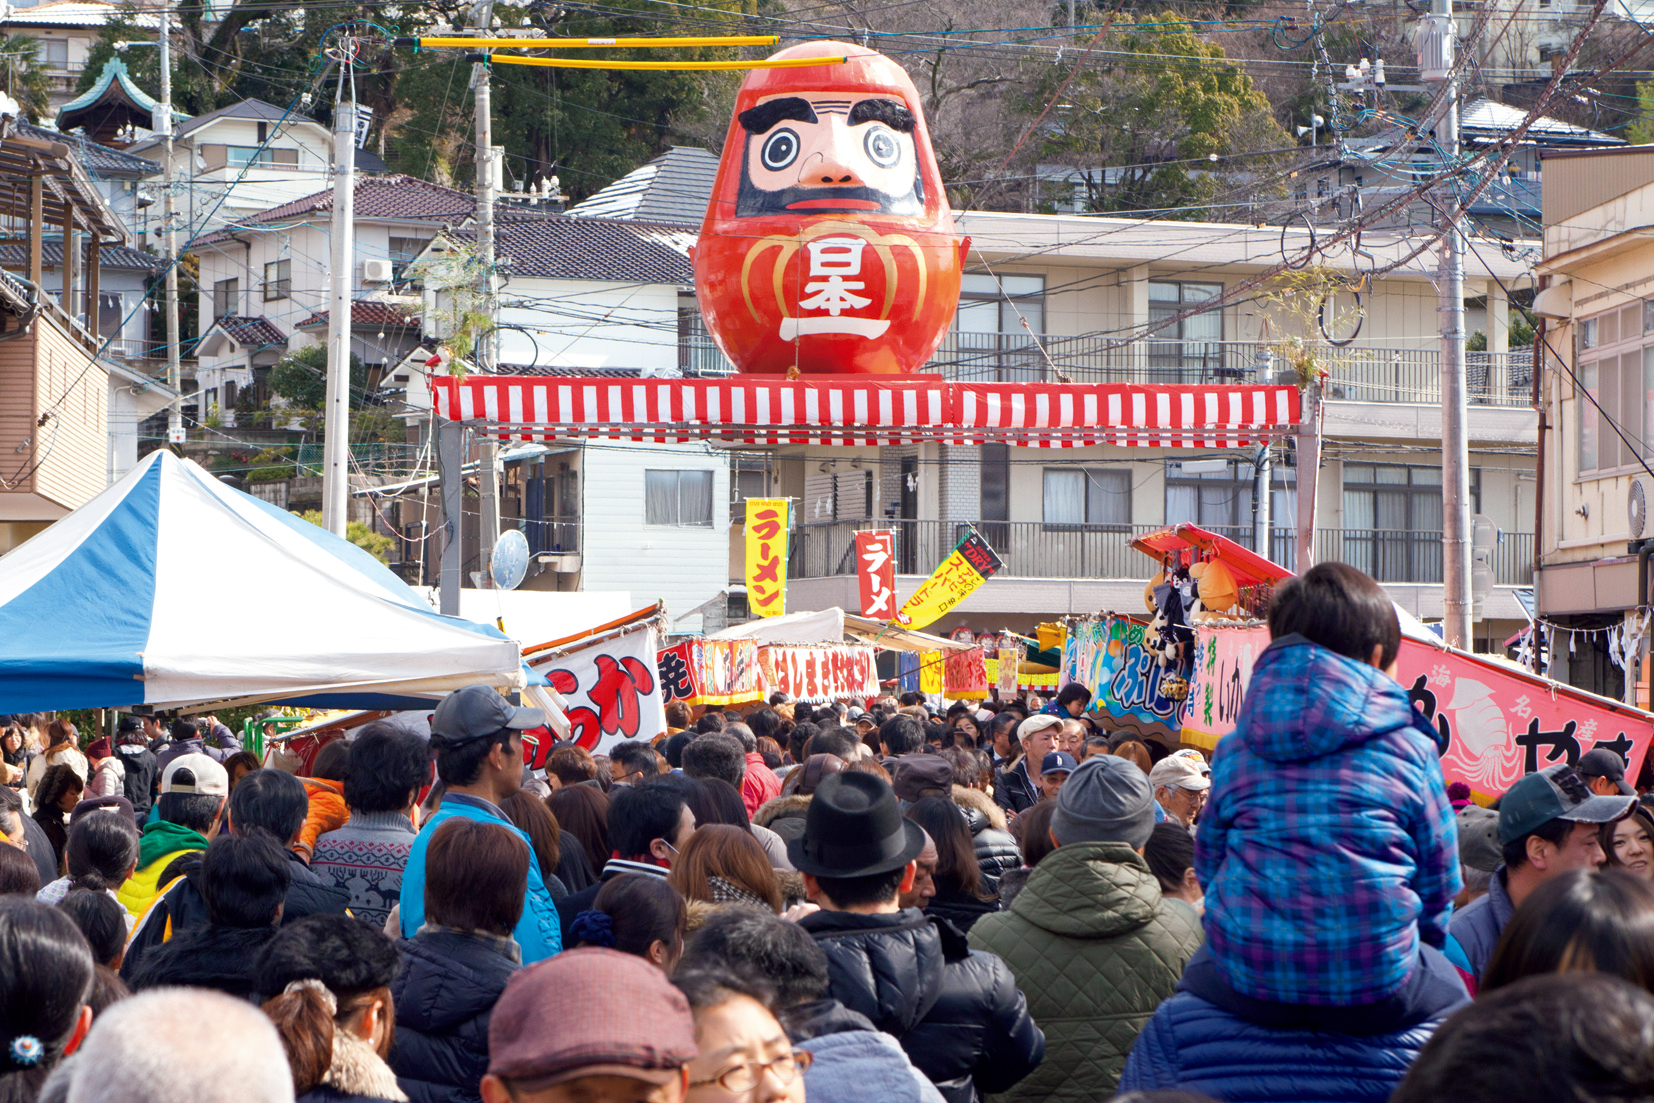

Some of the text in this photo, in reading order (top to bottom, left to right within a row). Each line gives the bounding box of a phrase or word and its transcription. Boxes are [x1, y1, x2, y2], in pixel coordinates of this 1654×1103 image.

[779, 237, 890, 342] 日本一
[752, 509, 781, 607] ラーメン
[903, 556, 964, 609] スーパードラ
[949, 567, 974, 592] アサヒ
